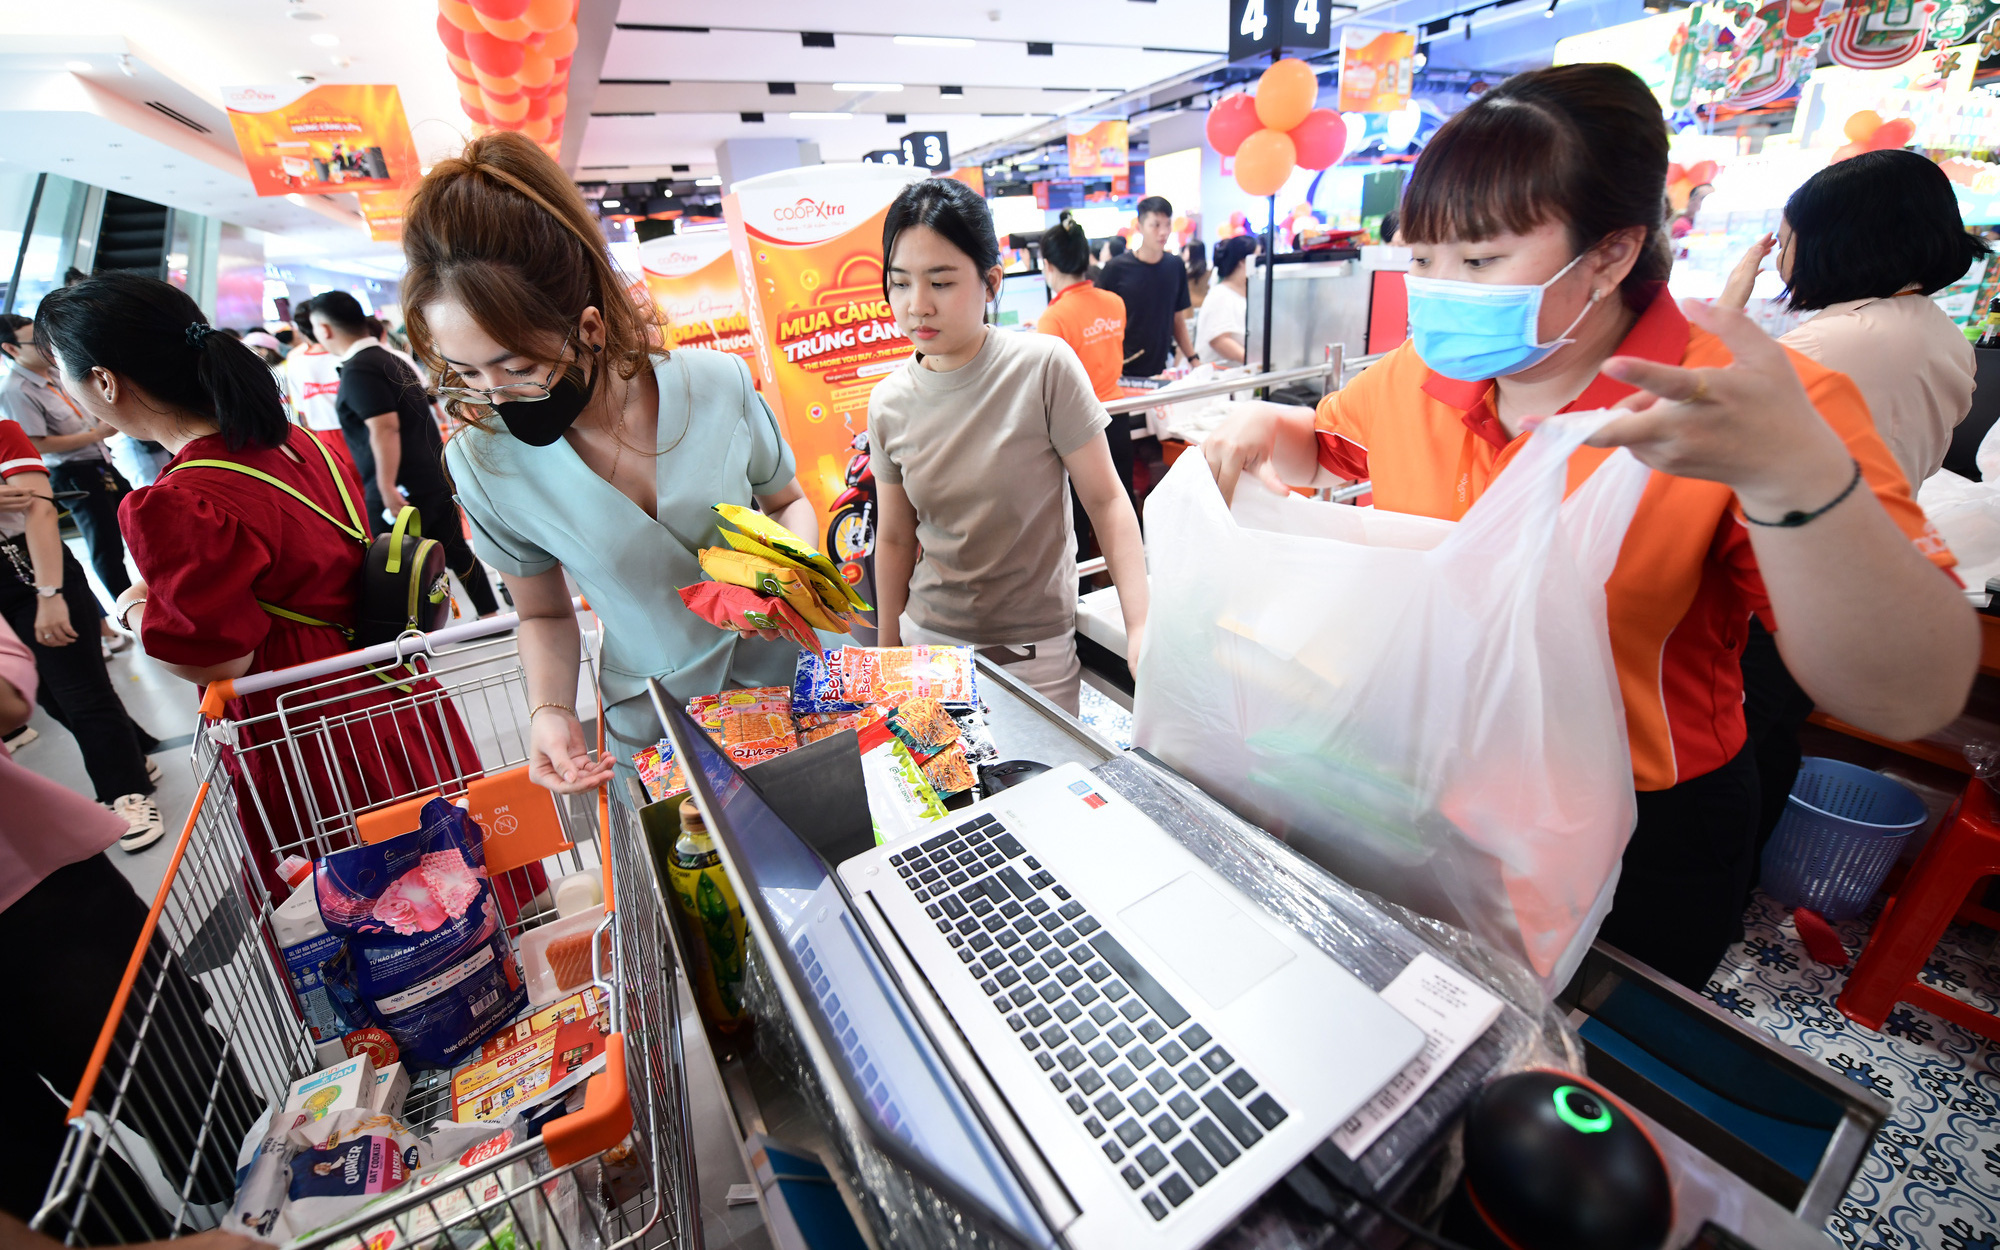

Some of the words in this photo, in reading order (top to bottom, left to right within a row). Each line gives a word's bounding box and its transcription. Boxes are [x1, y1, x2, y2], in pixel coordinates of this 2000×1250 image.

[1240, 0, 1267, 40] 4
[1294, 0, 1320, 35] 4
[924, 135, 943, 166] 3
[672, 320, 711, 342] DEAL
[780, 310, 831, 340] MUA
[834, 300, 891, 325] CÀNG
[783, 328, 856, 363] TRÚNG
[803, 362, 819, 371] THE
[819, 358, 841, 369] MORE
[842, 355, 857, 365] YOU
[858, 353, 872, 362] BUY
[877, 349, 891, 358] THE
[351, 1033, 365, 1043] MÙI
[366, 1031, 380, 1040] MỒ
[443, 1044, 458, 1054] Nước
[469, 1028, 479, 1039] OMO
[330, 1066, 354, 1081] FAN
[344, 1145, 363, 1185] QUAKER
[371, 1143, 381, 1167] COOKIES
[391, 1149, 402, 1181] RAISINS
[408, 1146, 417, 1165] NEW
[368, 1167, 378, 1184] OAT
